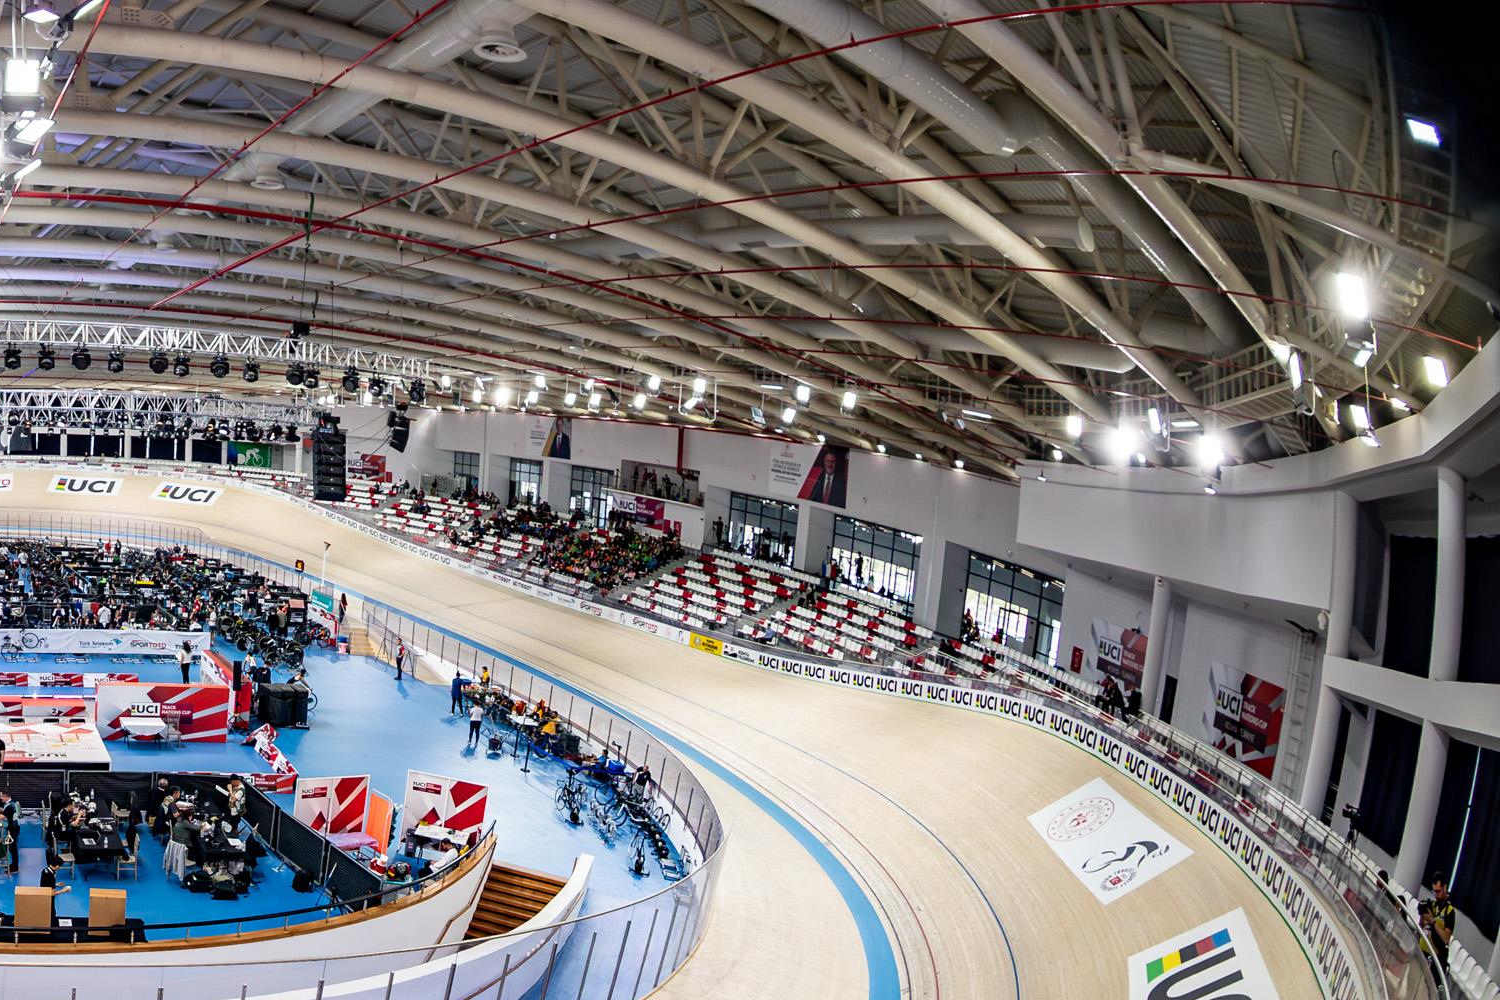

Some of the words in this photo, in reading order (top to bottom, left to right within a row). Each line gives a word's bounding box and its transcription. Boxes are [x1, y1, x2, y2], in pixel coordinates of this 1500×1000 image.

[67, 479, 116, 494] UCI
[169, 486, 216, 503] UCI
[622, 499, 635, 511] UCI
[1104, 642, 1120, 662] UCI
[763, 655, 780, 670] UCI
[786, 660, 802, 675] UCI
[808, 664, 825, 680] UCI
[833, 670, 850, 684] UCI
[856, 674, 874, 689] UCI
[880, 678, 897, 693] UCI
[905, 683, 922, 697] UCI
[930, 687, 948, 702] UCI
[954, 691, 972, 706] UCI
[136, 704, 159, 714] UCI
[980, 694, 997, 711] UCI
[1003, 700, 1021, 718] UCI
[1222, 692, 1241, 716] UCI
[1028, 706, 1046, 726] UCI
[1054, 715, 1072, 737] UCI
[1078, 725, 1097, 750] UCI
[1103, 738, 1122, 765] UCI
[1129, 753, 1148, 782] UCI
[1153, 768, 1172, 798] UCI
[1177, 784, 1196, 816] UCI
[1201, 802, 1220, 834] UCI
[1224, 819, 1242, 854] UCI
[1245, 837, 1263, 875] UCI
[1266, 858, 1284, 898] UCI
[1286, 880, 1304, 922] UCI
[1304, 901, 1322, 948] UCI
